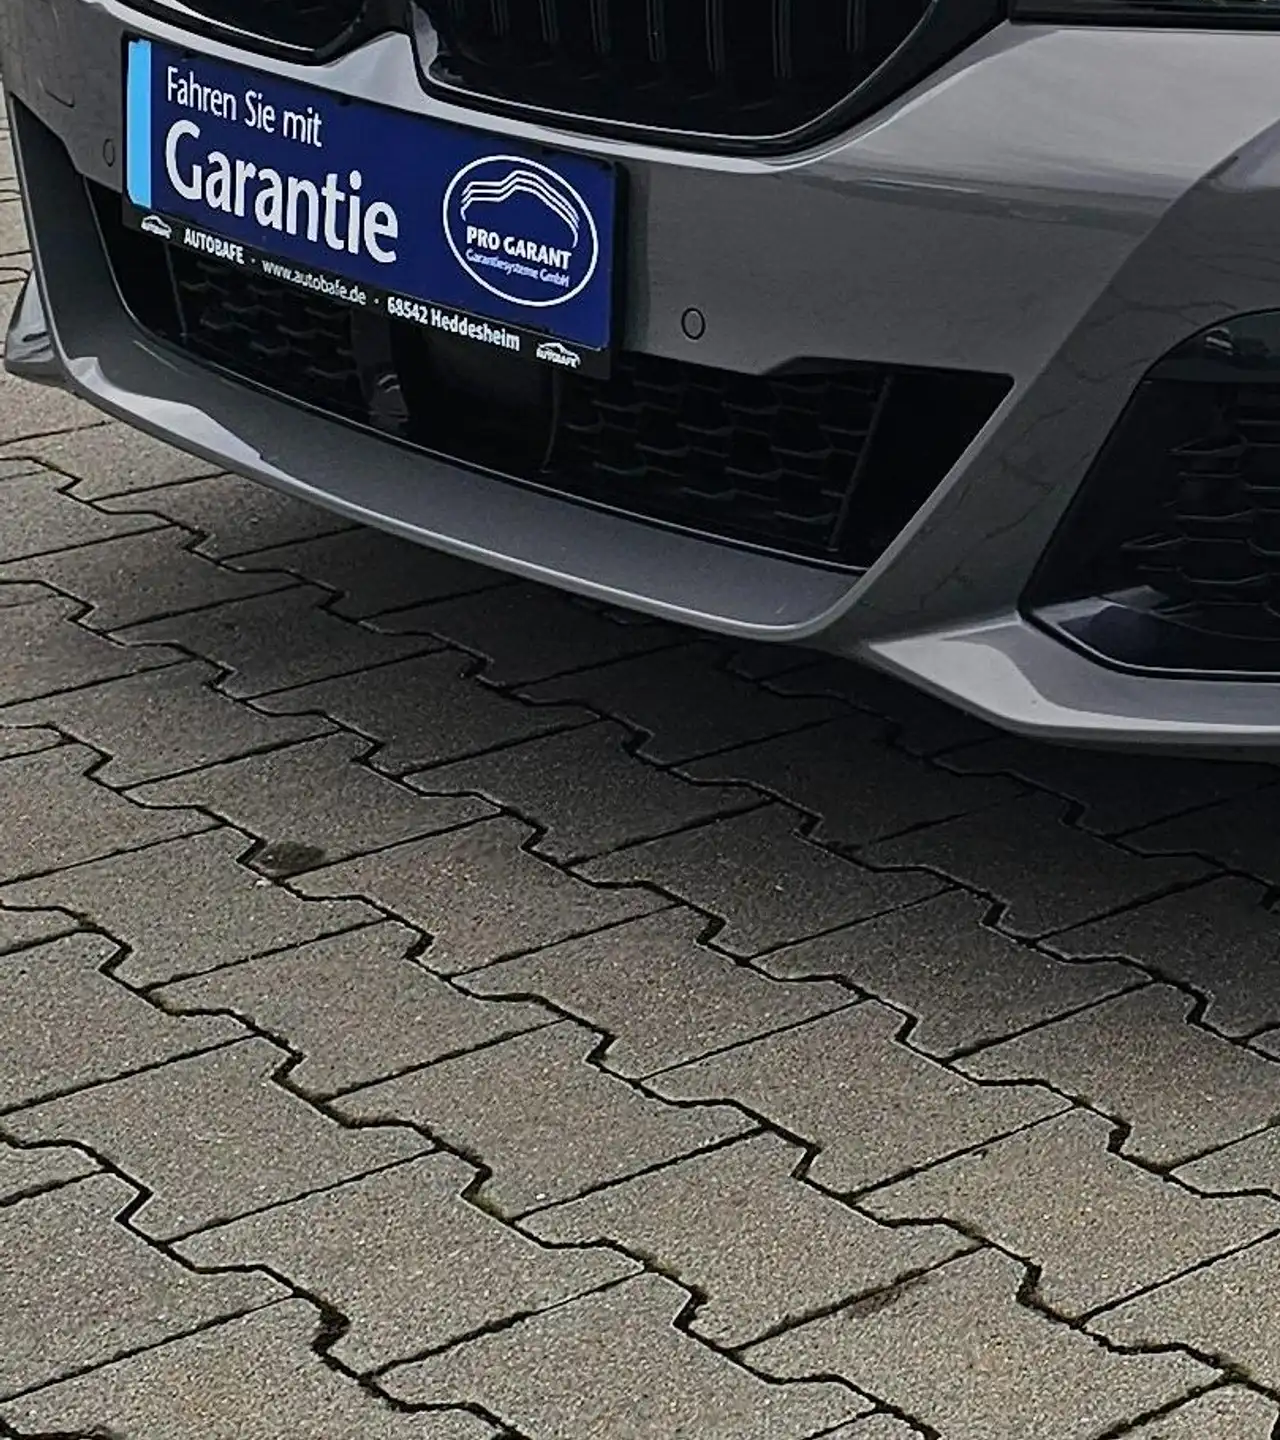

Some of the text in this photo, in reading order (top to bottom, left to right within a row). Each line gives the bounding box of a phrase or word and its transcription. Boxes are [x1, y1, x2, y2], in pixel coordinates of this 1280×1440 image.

[167, 65, 323, 148] Fahren Sie mit
[165, 119, 399, 264] Garantie
[183, 227, 245, 265] AUTOBAFE
[261, 259, 367, 306] www.autobafe.de
[387, 296, 429, 325] 68542
[431, 308, 521, 352] Heddesheim
[466, 225, 572, 270] PRO GARANT
